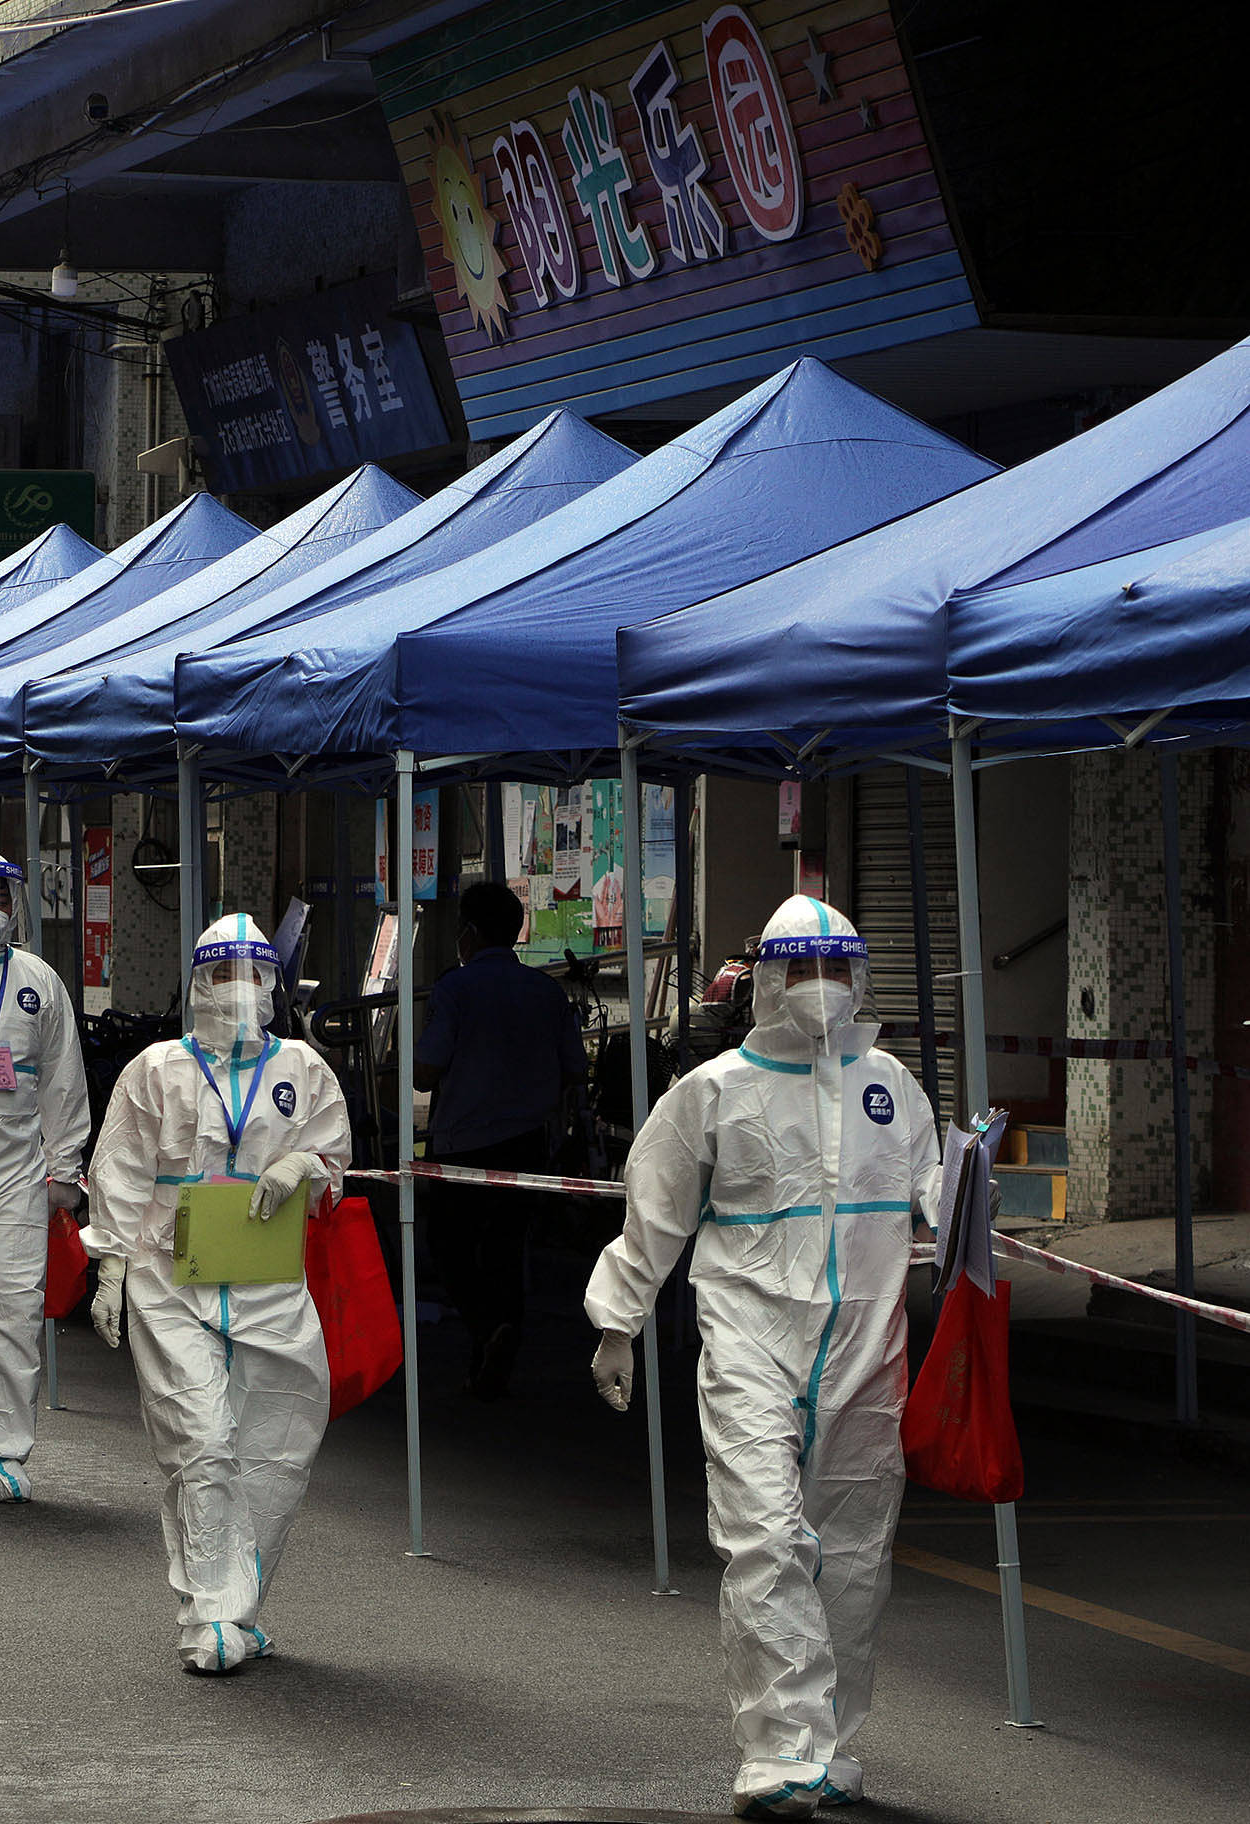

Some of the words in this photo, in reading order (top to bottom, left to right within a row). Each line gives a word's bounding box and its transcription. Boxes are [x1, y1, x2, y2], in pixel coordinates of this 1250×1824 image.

[492, 4, 804, 309] 阳光乐园
[305, 322, 405, 430] 警务室
[199, 947, 227, 960] FACE
[255, 946, 279, 960] SHIEL
[773, 942, 807, 954] FACE
